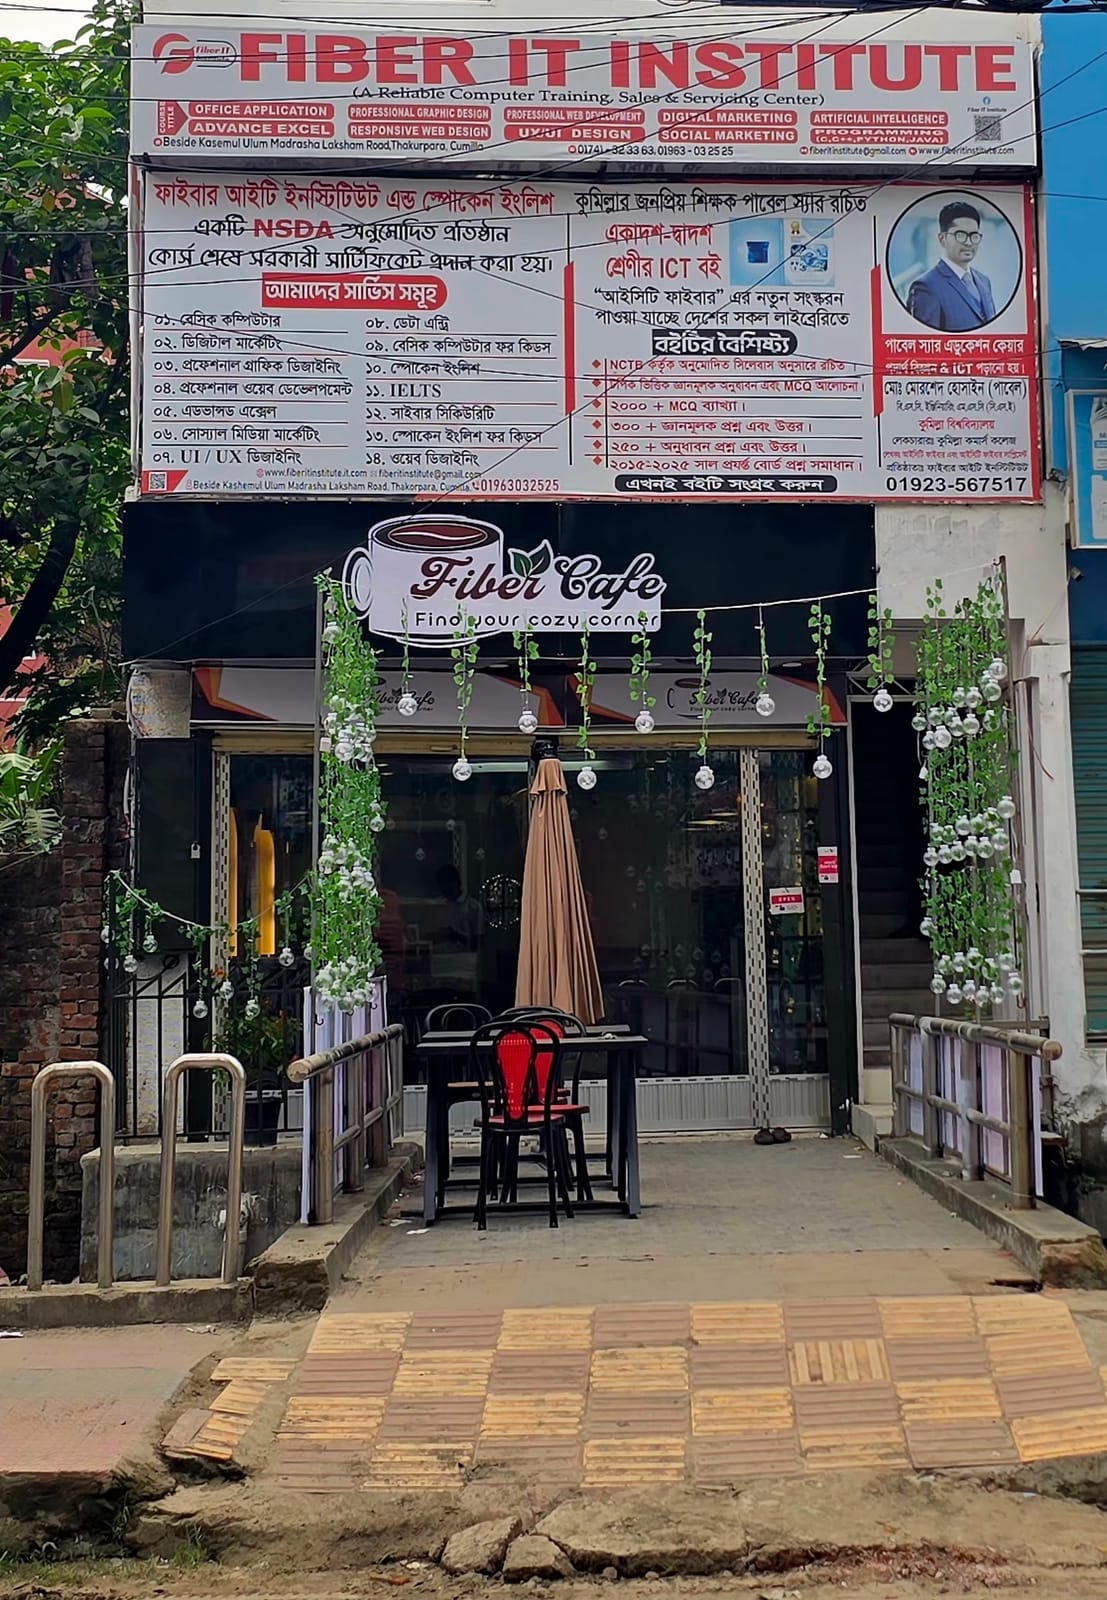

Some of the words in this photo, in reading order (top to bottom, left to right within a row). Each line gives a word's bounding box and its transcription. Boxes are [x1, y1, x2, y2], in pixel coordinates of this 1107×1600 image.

[240, 33, 474, 86] FIBER
[509, 38, 579, 87] IT
[611, 41, 1016, 92] INSTITUTE
[353, 87, 373, 99] (A
[379, 87, 445, 99] Reliable
[450, 88, 534, 104] Computer
[540, 89, 613, 105] Training,
[618, 92, 660, 104] Sales
[664, 93, 679, 104] &
[683, 92, 759, 107] Servicing
[763, 94, 825, 106] Center)
[195, 104, 240, 116] OFFICE
[244, 104, 327, 117] APPLICATION
[350, 107, 415, 118] PROFESSIONAL
[417, 108, 455, 119] GRAPHIC
[457, 108, 490, 120] DESIGN
[506, 110, 565, 120] PROFESSIONAL
[566, 110, 584, 120] WEB
[585, 110, 642, 122] DEVELOPMENT
[663, 112, 713, 122] DIGITAL
[716, 112, 793, 123] MARKETING
[814, 113, 870, 124] ARTIFICIAL
[872, 114, 945, 125] INTELLIGENCE
[193, 123, 273, 134] ADVANCE
[277, 124, 330, 135] EXCEL
[350, 126, 419, 136] RESPONSIVE
[421, 126, 446, 136] WEB
[449, 127, 489, 138] DESIGN
[518, 128, 562, 139] UX/UI
[572, 129, 631, 140] DESIGN
[662, 130, 713, 140] SOCIAL
[715, 130, 795, 141] MARKETING
[163, 137, 196, 148] Beside
[199, 138, 241, 149] Kasemul
[243, 138, 267, 148] Ulum
[270, 138, 320, 150] Madrasha
[322, 139, 364, 150] Laksham
[450, 141, 484, 151] Cumilla
[153, 176, 220, 208] ফাইবার
[224, 179, 280, 208] আইটি
[284, 180, 381, 211] ইনস্টিটিউট
[386, 190, 416, 211] এন্ড
[422, 190, 494, 215] স্পোকেন
[499, 186, 554, 216] ইংলিশ
[574, 188, 630, 216] কুমিল্লার
[635, 189, 686, 213] জনপ্রিয়
[690, 187, 738, 213] শিক্ষক
[741, 194, 788, 213] পাবেল
[792, 194, 825, 214] স্যার
[830, 188, 870, 213] রচিত
[194, 214, 248, 236] একটি
[254, 218, 334, 239] NSDA
[341, 219, 440, 244] অনুমোদিত
[443, 220, 511, 242] প্রতিষ্ঠান
[605, 222, 714, 246] একাদশ-দ্বাদশ
[148, 242, 196, 266] কোর্স
[200, 249, 244, 267] শেষে
[248, 245, 320, 268] সরকারী
[325, 246, 425, 270] সার্টিফিকেট
[430, 254, 474, 271] প্রদান
[480, 256, 514, 272] করা
[606, 248, 654, 278] শ্রেণীর
[660, 258, 691, 278] ICT
[697, 251, 722, 280] বই
[264, 280, 341, 302] আমাদের
[343, 276, 396, 301] সার্ভিস
[398, 282, 438, 309] সমূহ
[730, 291, 751, 305] এর
[756, 292, 790, 310] নতুন
[595, 310, 638, 325] পাওয়া
[641, 310, 681, 327] যাচ্ছে
[684, 310, 730, 326] দেশের
[733, 312, 768, 326] সকল
[774, 308, 850, 328] লাইব্রেরিতে
[154, 338, 176, 349] ০২.
[182, 334, 231, 350] ডিজিটাল
[236, 334, 283, 351] মার্কেটিং
[654, 330, 716, 354] বইটির
[716, 331, 790, 354] বৈশিষ্ট্য
[884, 339, 916, 353] পাবেল
[918, 339, 942, 353] স্যার
[944, 339, 990, 356] এডুকেশন
[992, 339, 1024, 353] কেয়ার
[154, 361, 178, 372] ০৩.
[182, 358, 240, 373] প্রফেশনাল
[243, 358, 284, 373] গ্রাফিক
[287, 357, 342, 374] ডিজাইনিং
[366, 385, 384, 397] ১১.
[390, 384, 442, 398] IELTS
[154, 406, 177, 418] ০৫.
[239, 406, 278, 420] এক্সেল
[366, 408, 386, 420] ১২.
[390, 406, 432, 420] সাইবার
[436, 404, 496, 421] সিকিউরিটি
[610, 401, 648, 412] ২০০০
[653, 402, 664, 412] +
[669, 401, 698, 412] MCQ
[702, 400, 737, 412] ব্যাখ্যা
[154, 429, 177, 440] ০৬.
[182, 428, 227, 442] সোস্যাল
[232, 425, 270, 442] মিডিয়া
[274, 424, 320, 442] মার্কেটিং
[366, 430, 388, 442] ১৩.
[392, 430, 442, 444] স্পোকেন
[445, 428, 482, 444] ইংলিশ
[486, 430, 504, 444] ফর
[508, 428, 542, 444] কিডস
[610, 442, 640, 452] ২৫০
[646, 442, 656, 452] +
[660, 442, 710, 454] অনুধাবন
[714, 442, 736, 453] প্রশ্ন
[740, 442, 764, 453] এবং
[768, 440, 798, 453] উত্তর
[152, 452, 174, 464] ০৭.
[181, 450, 200, 464] UI
[216, 450, 242, 464] UX
[247, 448, 302, 464] ডিজাইনিং
[366, 452, 386, 465] ১৪.
[390, 452, 421, 466] ওয়েব
[425, 450, 480, 466] ডিজাইনিং
[480, 480, 560, 492] 01963032525
[626, 476, 678, 492] এখনই
[684, 476, 724, 491] বইটি
[728, 478, 776, 492] সংগ্রহ
[779, 478, 824, 492] করুন
[886, 477, 1027, 492] 01923-567517
[410, 556, 546, 600] Fiber
[554, 555, 664, 611] Cafe
[528, 616, 579, 629] cozy
[588, 616, 658, 626] corner
